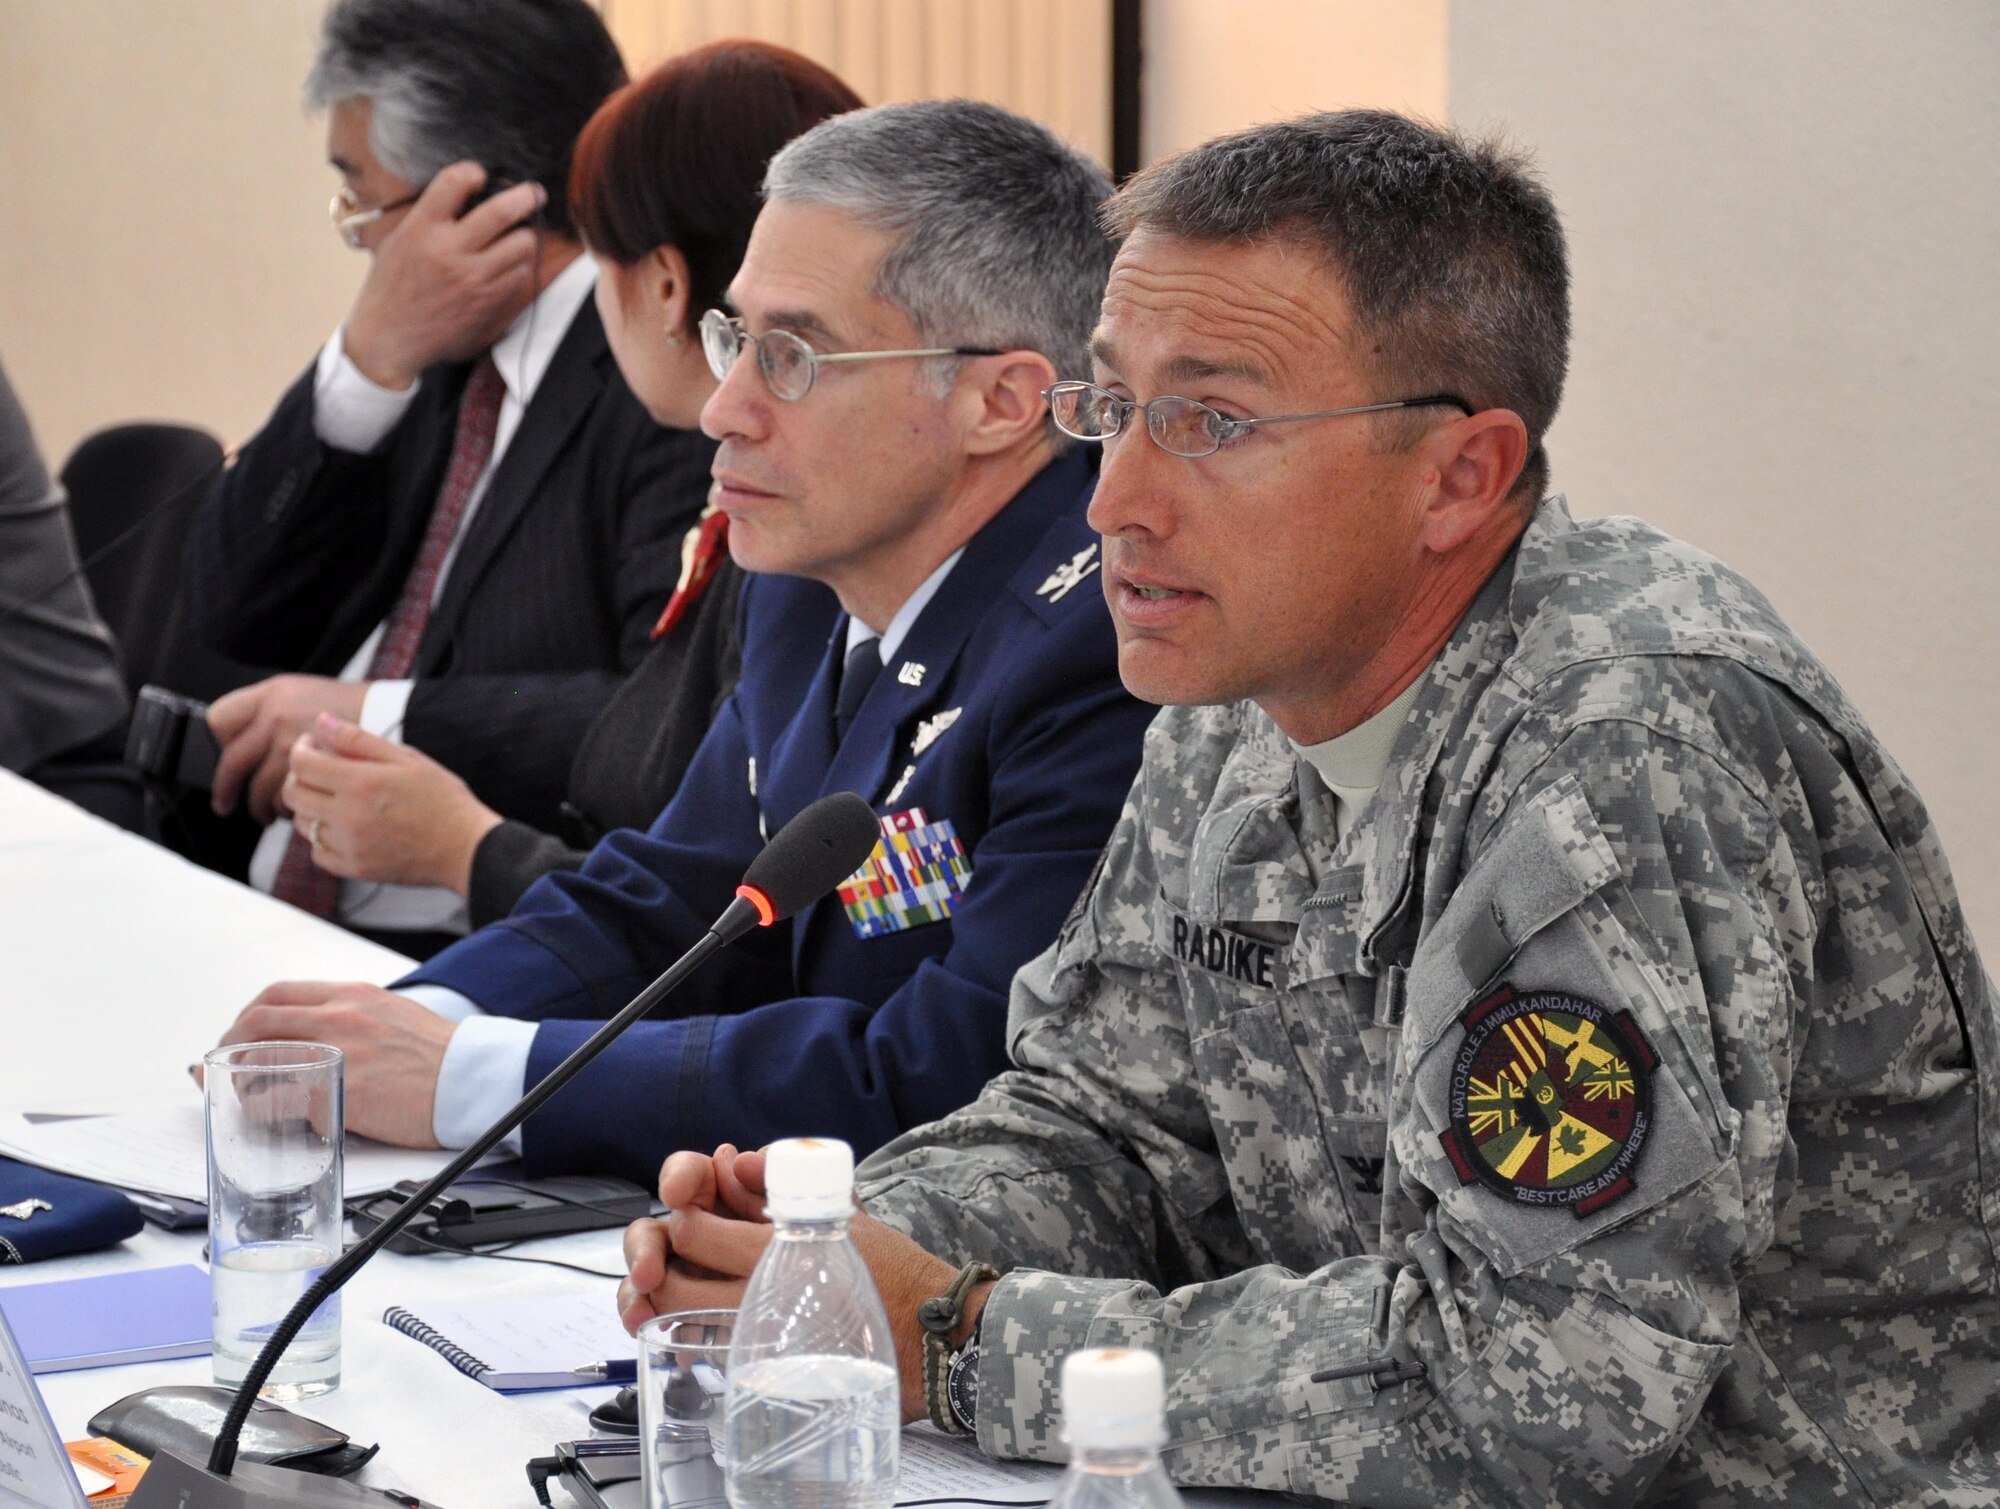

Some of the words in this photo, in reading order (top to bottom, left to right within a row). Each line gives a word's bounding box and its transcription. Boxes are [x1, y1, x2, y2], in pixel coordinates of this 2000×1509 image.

[1173, 914, 1276, 989] RADIKE
[1519, 996, 1602, 1022] KANDAHAR
[1476, 1025, 1489, 1036] 3
[1457, 1034, 1482, 1075] ROLE
[1452, 1076, 1466, 1118] NATO
[1556, 1181, 1598, 1202] CARE
[956, 1361, 966, 1371] 20
